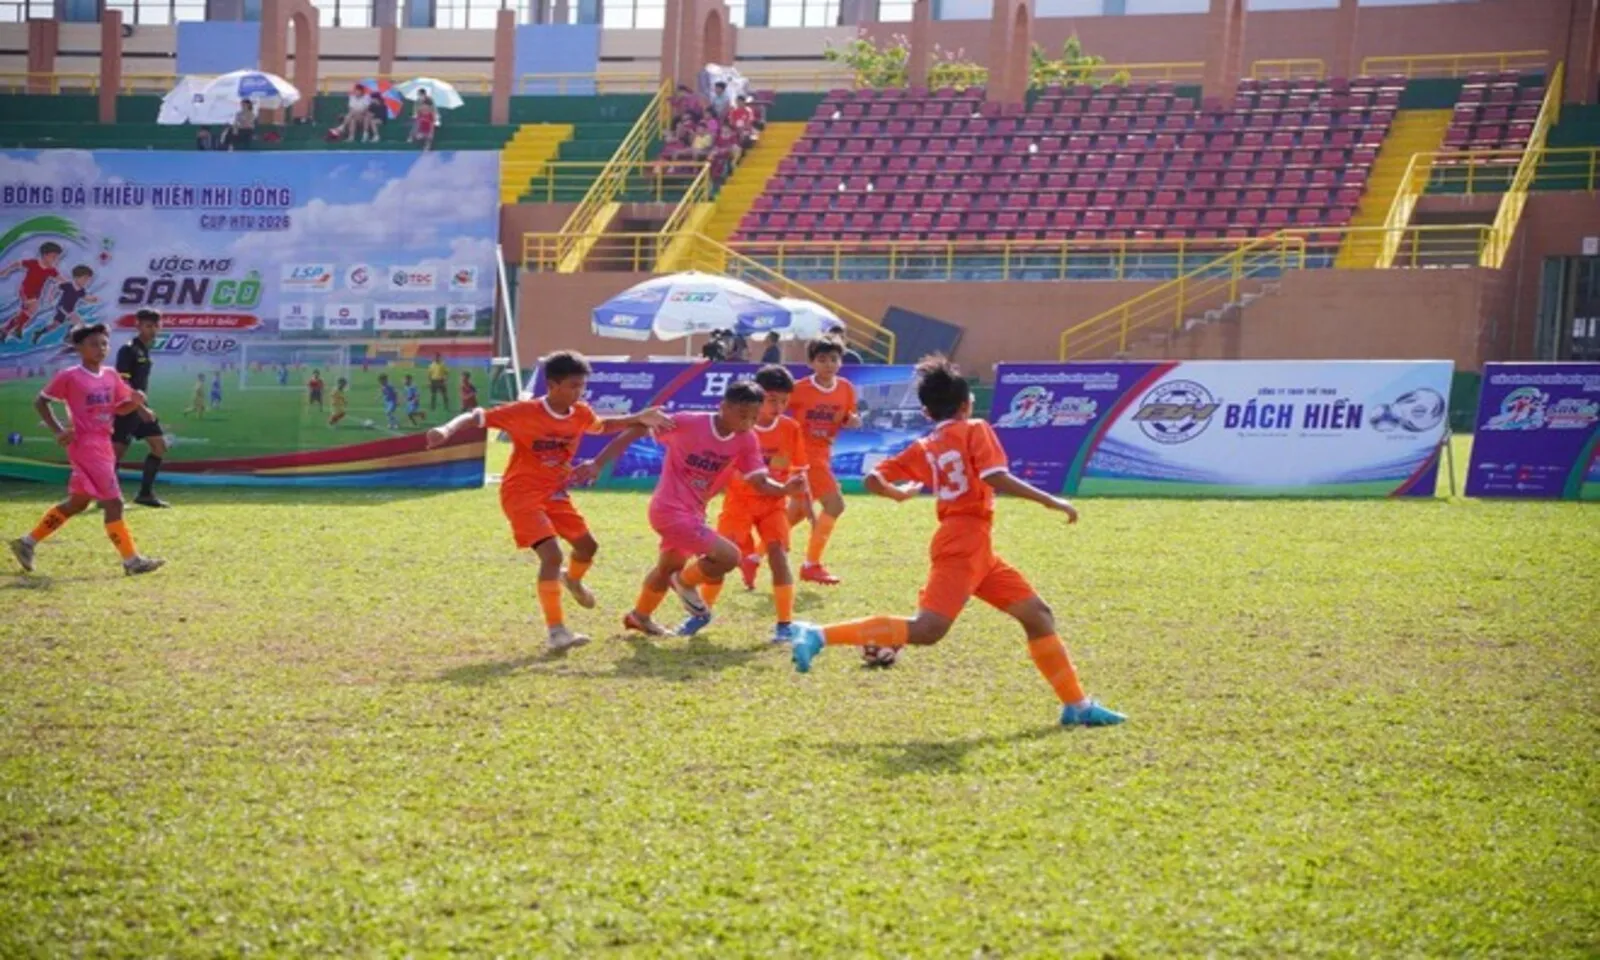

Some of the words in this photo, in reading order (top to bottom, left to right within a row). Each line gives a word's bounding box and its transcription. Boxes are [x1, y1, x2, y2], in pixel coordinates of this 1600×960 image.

[201, 187, 233, 206] NHI
[258, 215, 291, 229] 2026
[118, 272, 210, 306] SÂN
[211, 270, 262, 306] CỎ
[1224, 398, 1294, 429] BÁCH
[925, 449, 969, 500] 13
